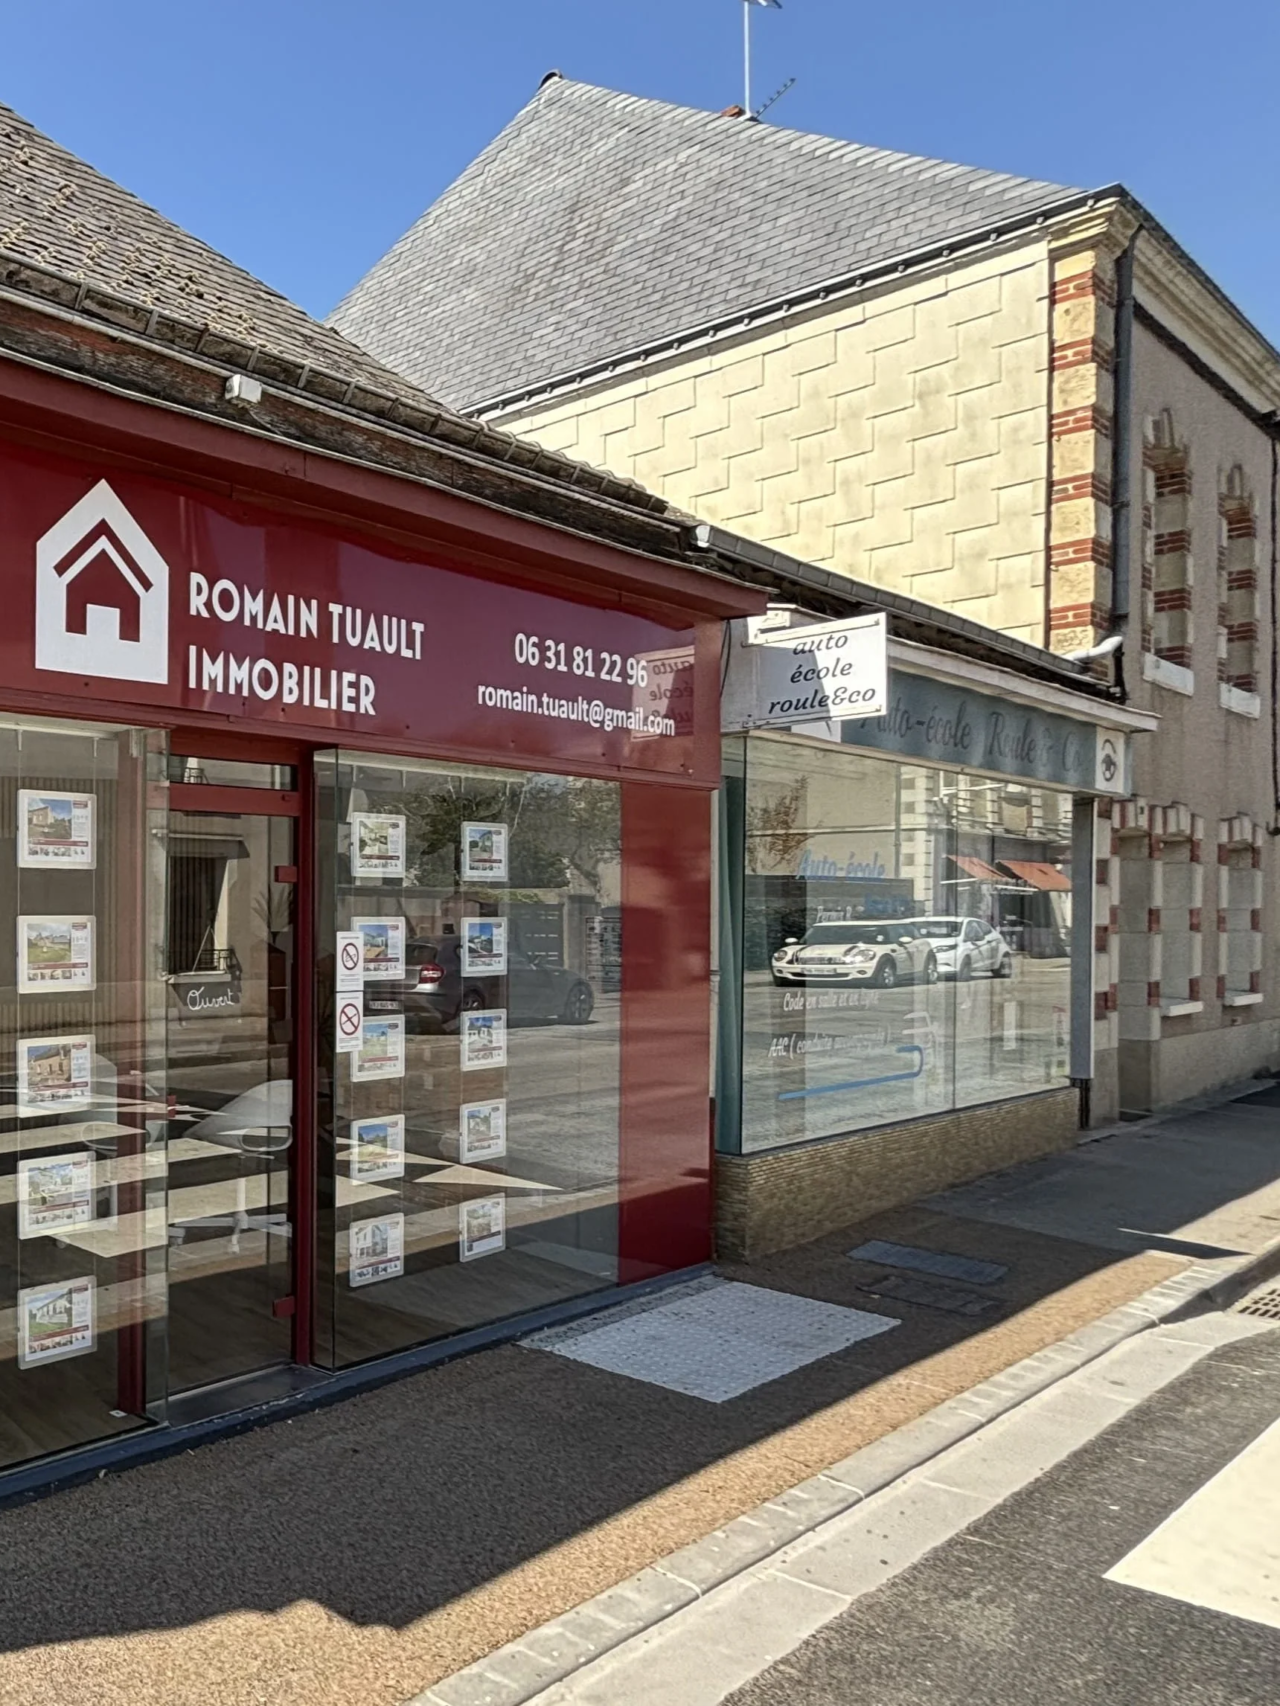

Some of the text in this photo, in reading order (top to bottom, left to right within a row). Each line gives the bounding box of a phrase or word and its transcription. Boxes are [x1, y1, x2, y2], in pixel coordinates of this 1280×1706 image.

[189, 571, 424, 661] ROMAIN TUAULT
[514, 632, 648, 688] 06 31 81 22 96
[790, 657, 853, 684] école
[792, 634, 849, 655] auto
[188, 645, 376, 716] IMMOBILIER
[768, 686, 876, 715] roule&co
[477, 684, 675, 737] romain.tuault@gmail.com
[859, 697, 970, 750] uto-école
[187, 986, 234, 1011] Ouvert
